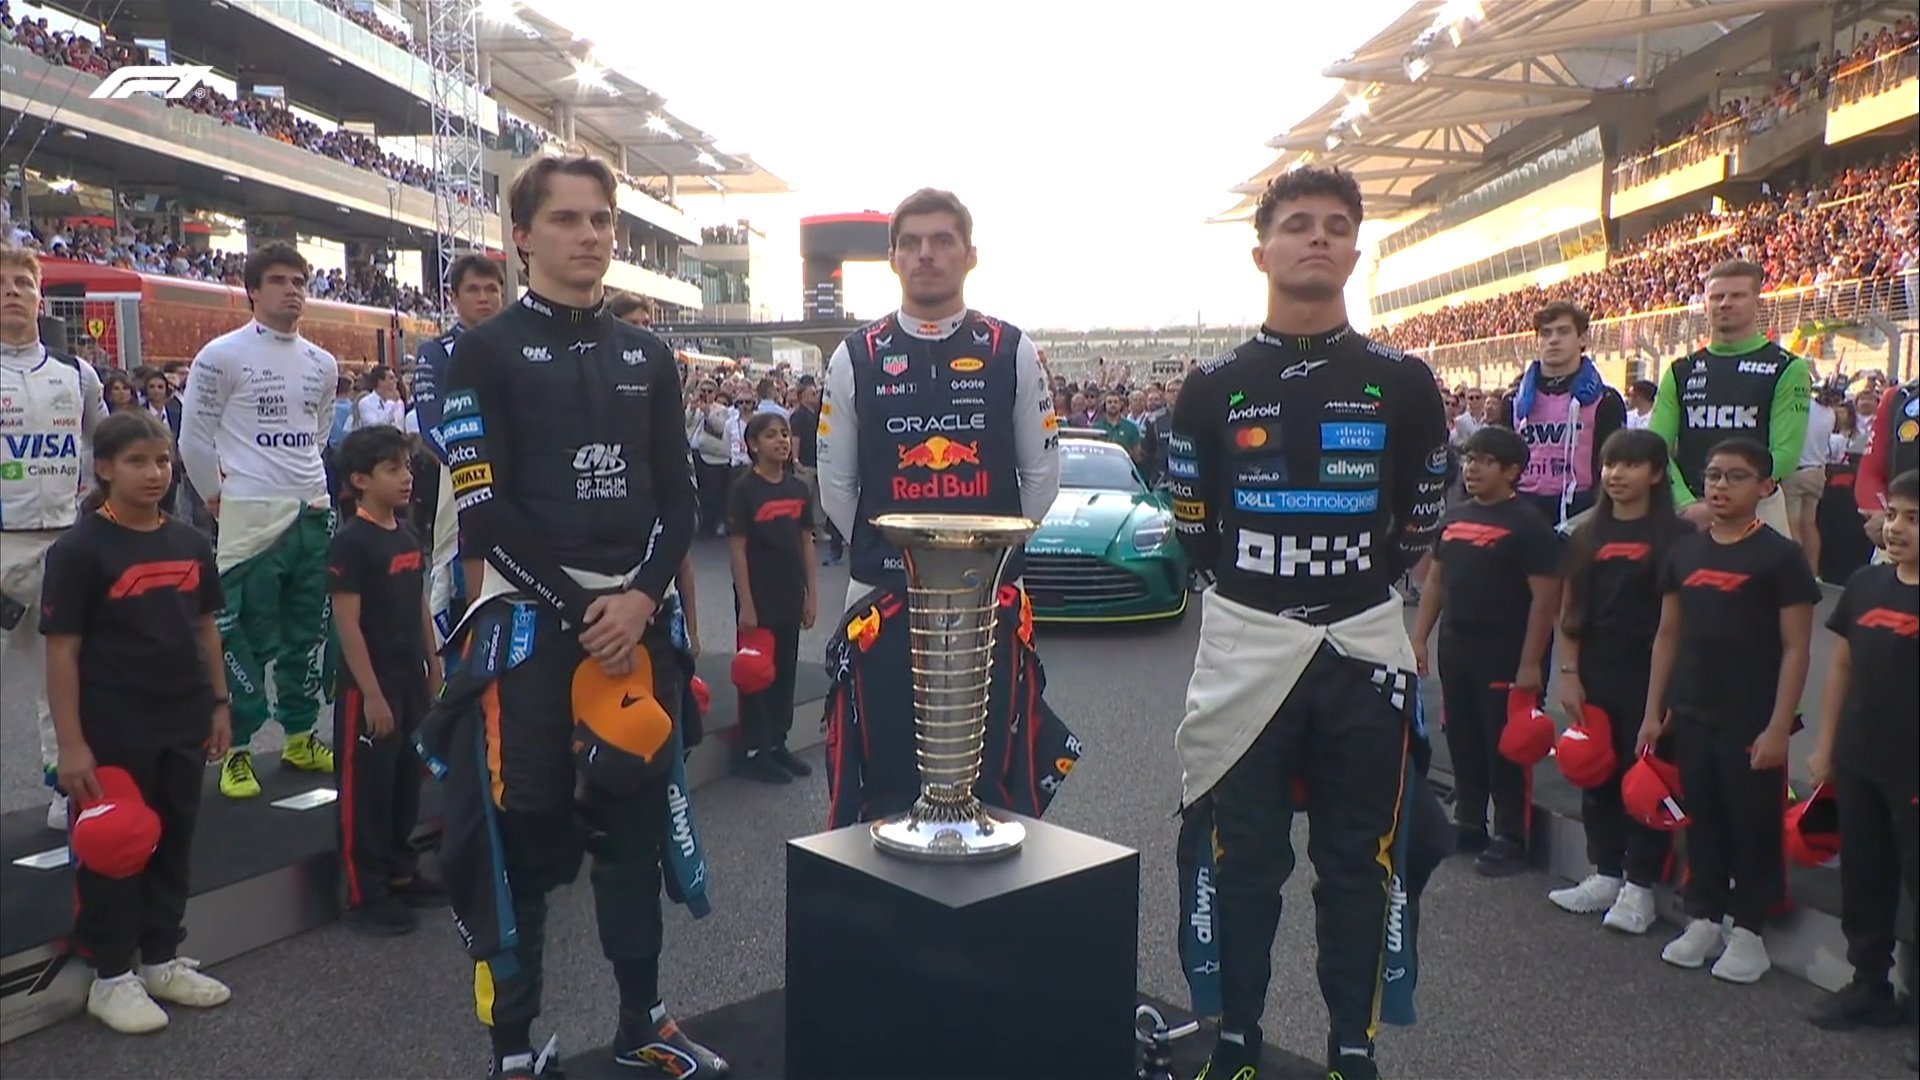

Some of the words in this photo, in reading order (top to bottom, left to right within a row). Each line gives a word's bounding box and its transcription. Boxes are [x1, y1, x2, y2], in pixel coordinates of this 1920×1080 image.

[1738, 360, 1778, 374] KICK
[876, 384, 905, 396] Mobil
[1228, 402, 1281, 423] Android
[1325, 401, 1376, 411] McLaren
[886, 413, 986, 433] ORACLE
[1686, 405, 1759, 428] KICK
[6, 433, 77, 459] VISA
[448, 446, 477, 465] okta
[1061, 446, 1104, 455] ARTIN
[28, 464, 58, 476] Cash
[1248, 472, 1280, 482] WORLD
[1326, 460, 1375, 478] allwyn
[892, 473, 939, 501] Red
[942, 471, 988, 498] Bull
[1237, 492, 1275, 508] DELL
[1277, 492, 1375, 511] Technologies
[1031, 547, 1058, 555] SAFETY
[1235, 528, 1371, 576] OKX
[492, 545, 536, 584] RICHARD
[533, 580, 566, 610] MILLE
[668, 784, 696, 858] allwyn
[1191, 867, 1217, 944] allwyn
[1387, 874, 1407, 953] allwyn
